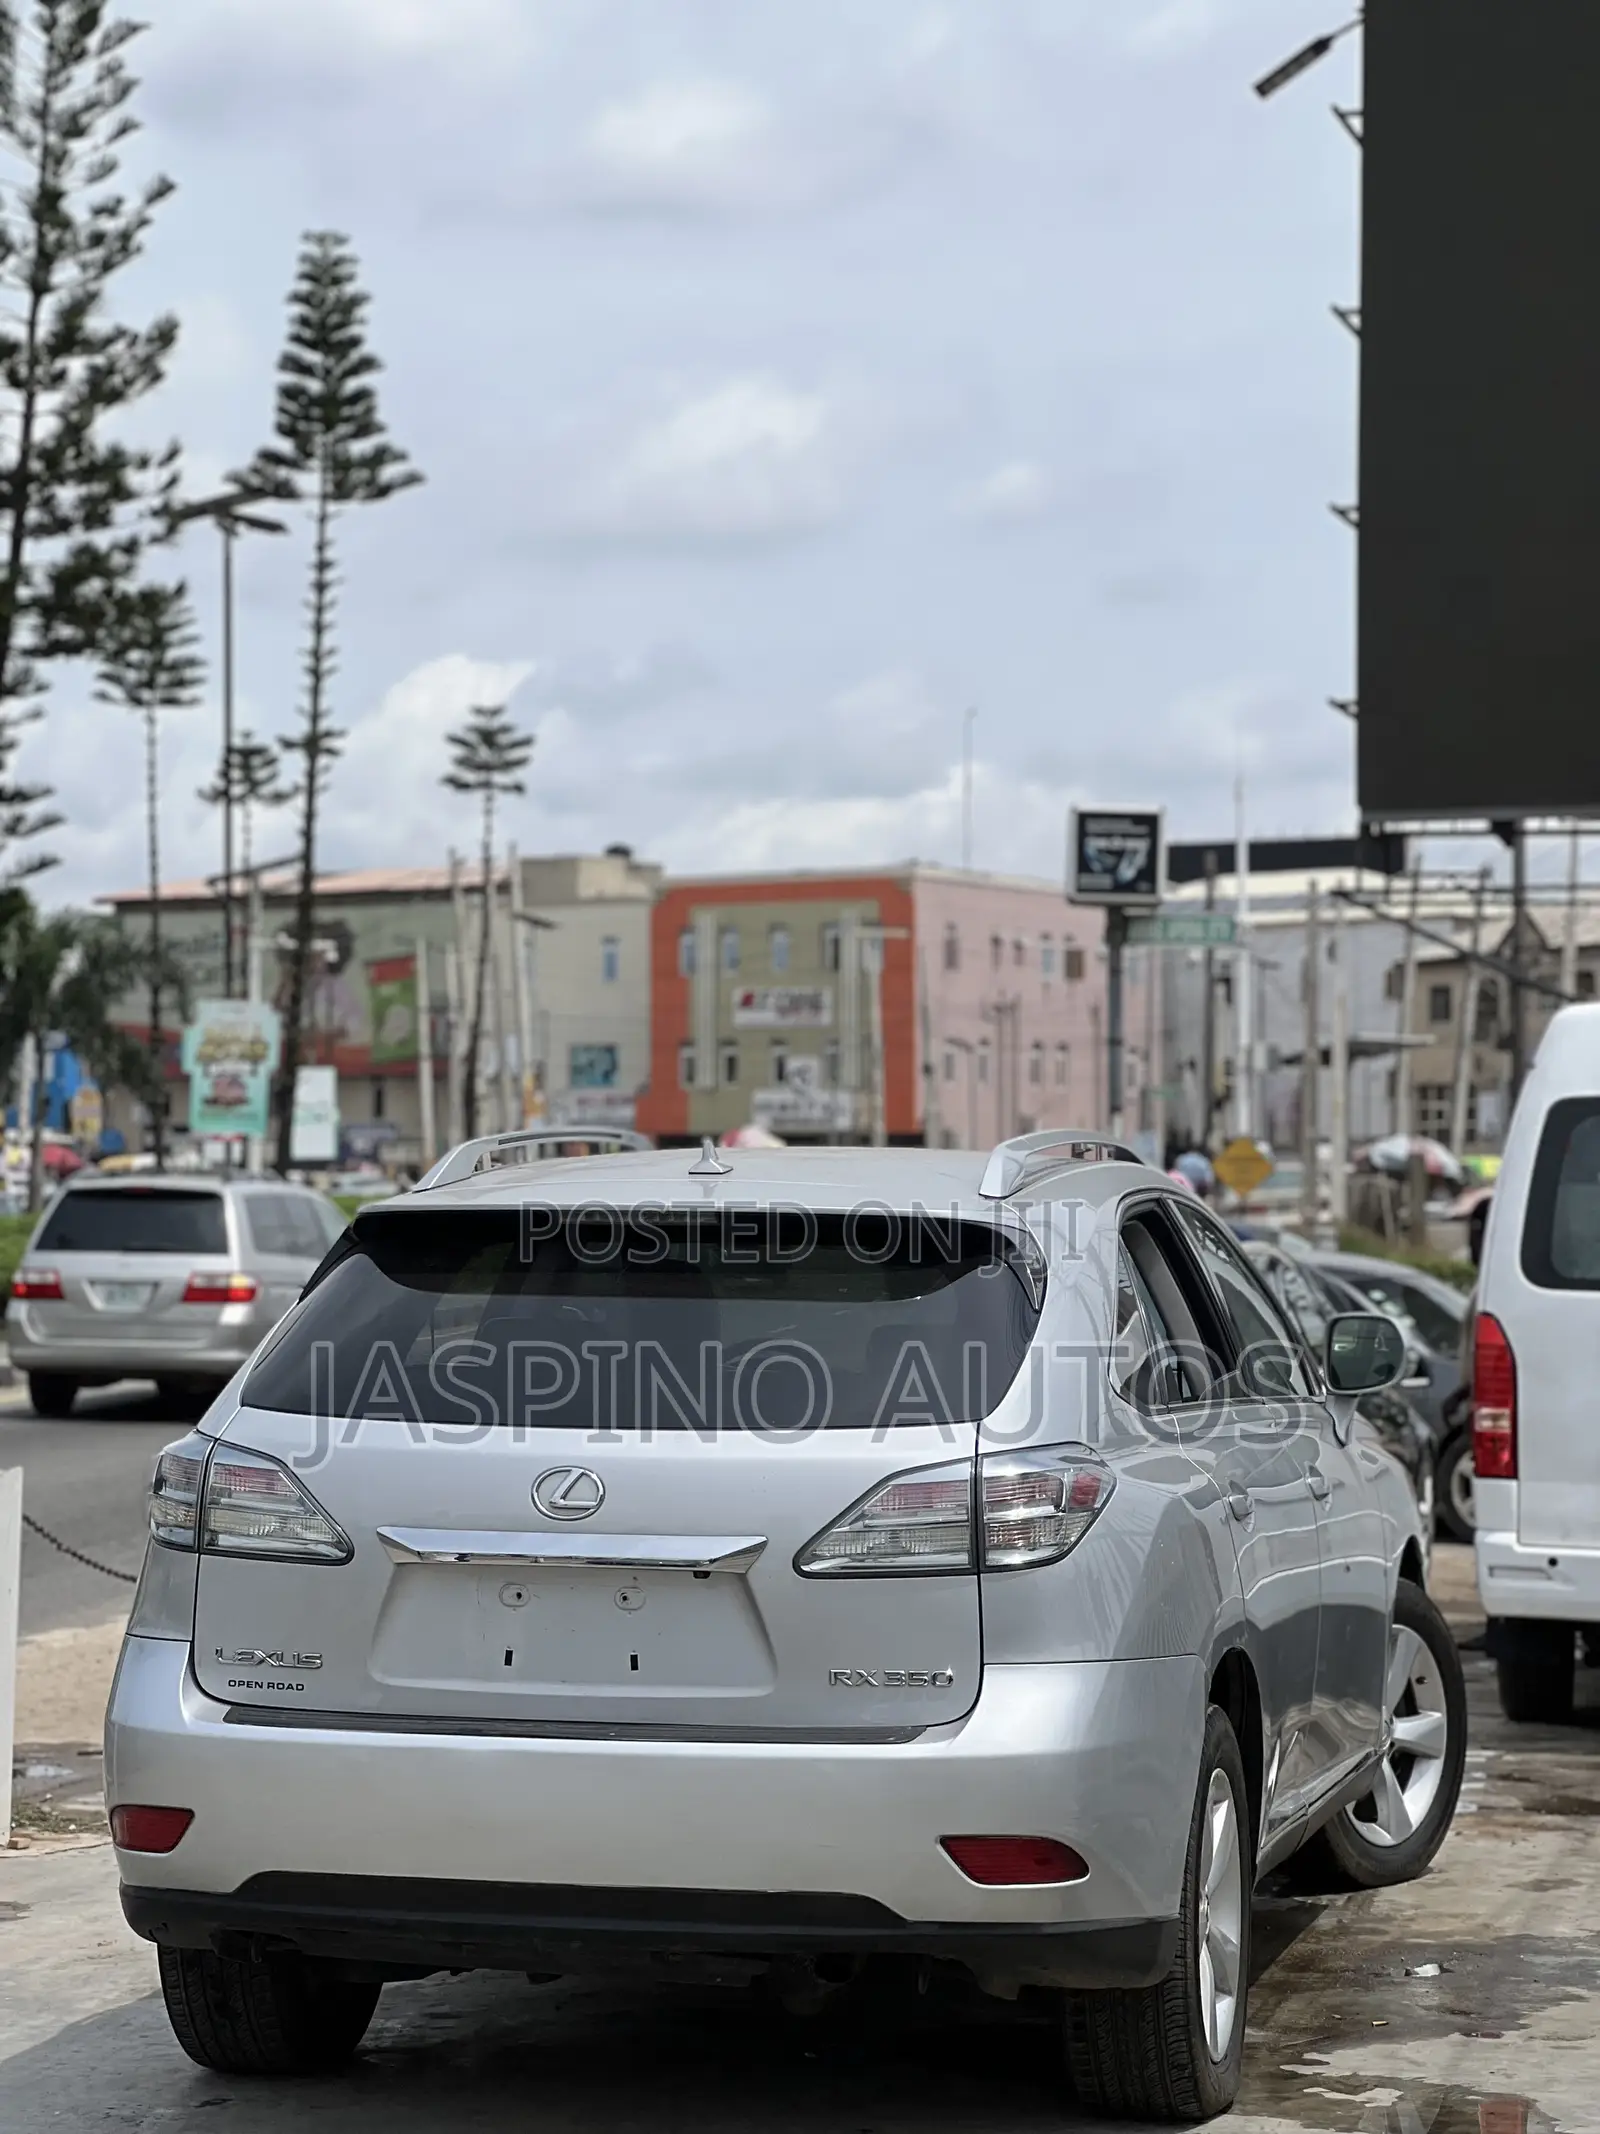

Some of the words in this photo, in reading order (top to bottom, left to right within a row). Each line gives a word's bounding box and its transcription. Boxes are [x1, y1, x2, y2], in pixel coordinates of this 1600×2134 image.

[214, 1646, 323, 1670] LEXUS
[227, 1679, 264, 1690] OPEN
[266, 1681, 305, 1692] ROAD
[828, 1668, 879, 1687] RX
[883, 1668, 955, 1688] 350
